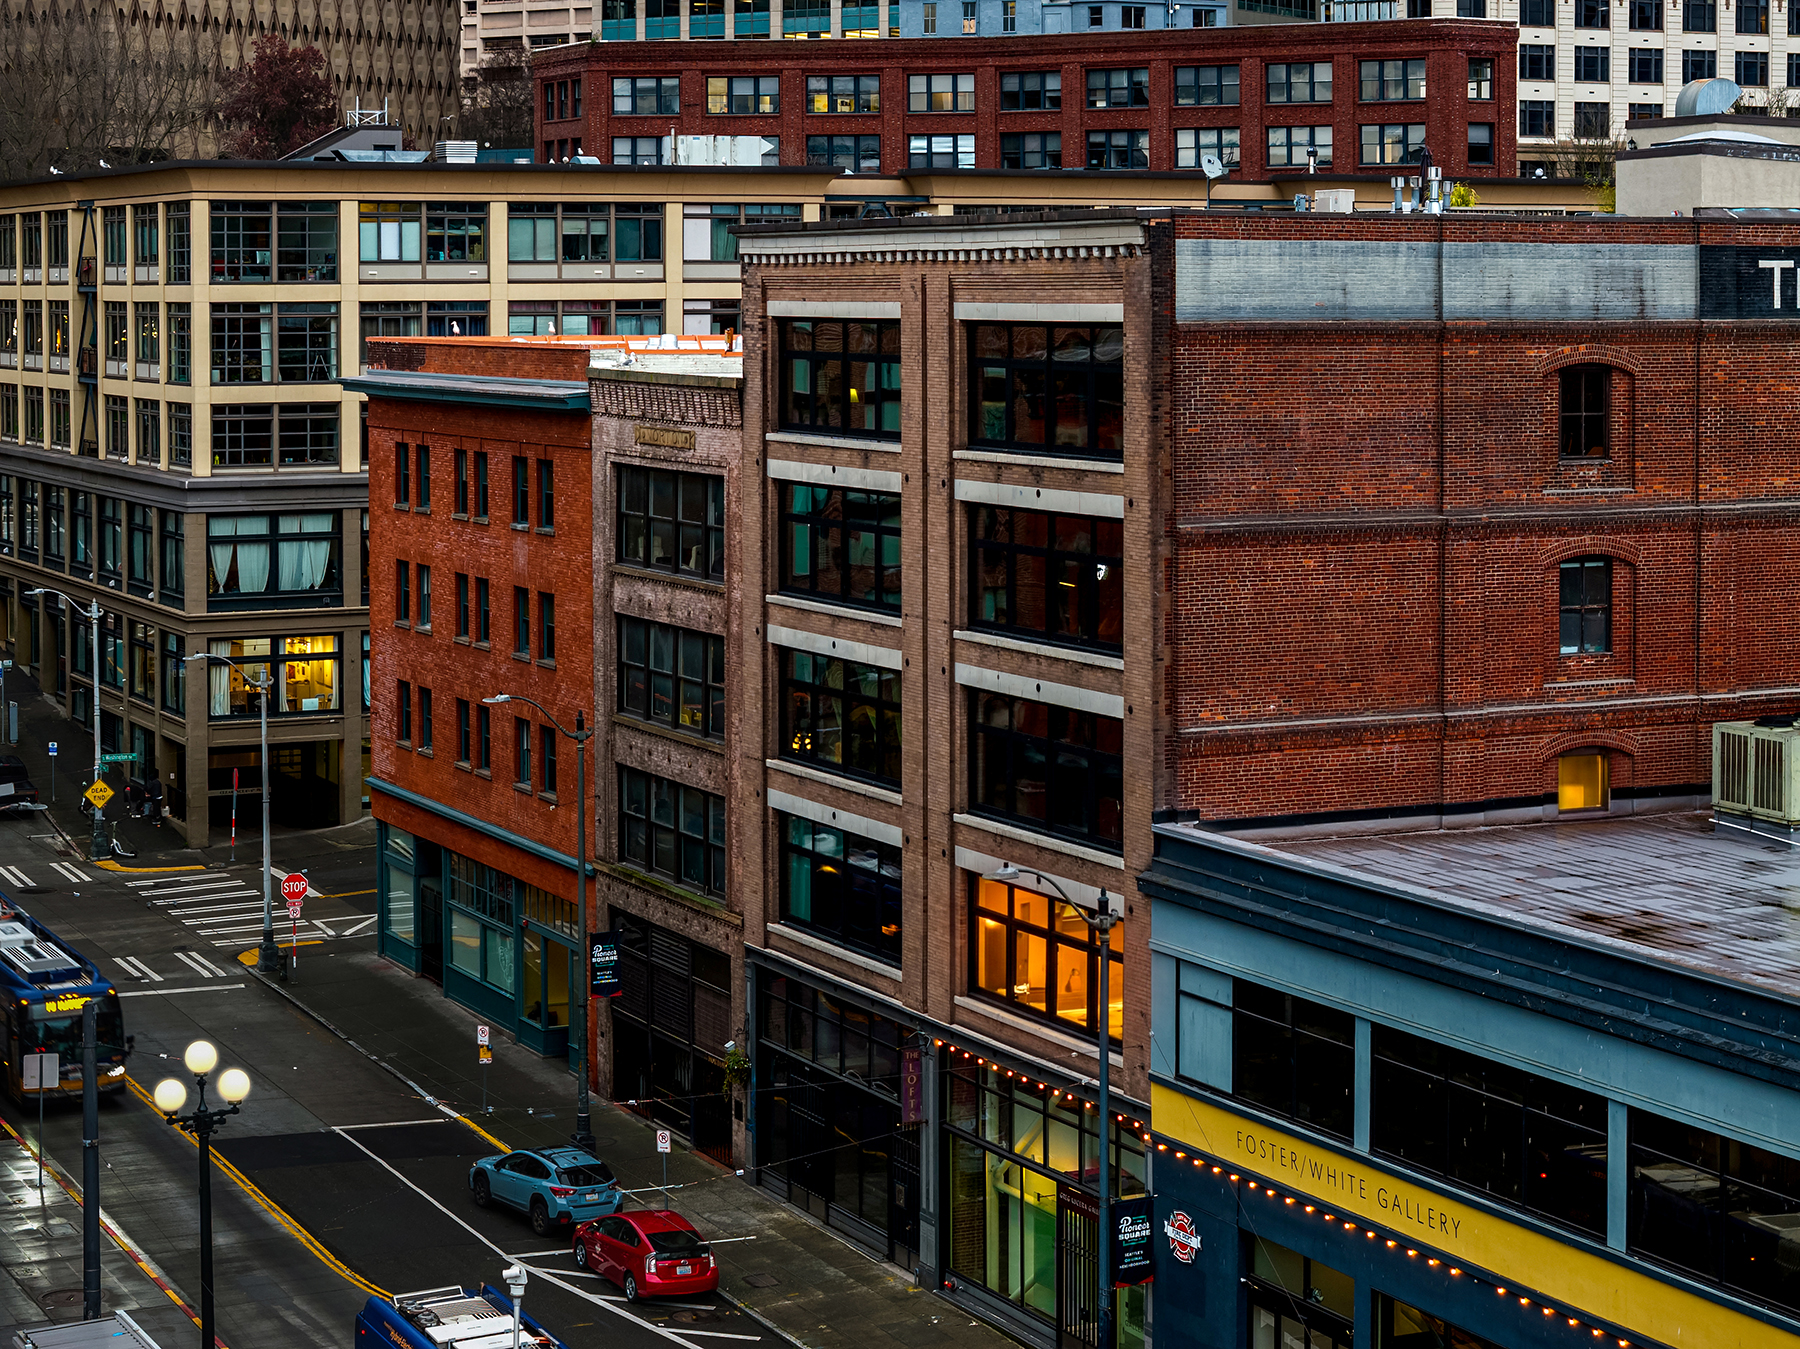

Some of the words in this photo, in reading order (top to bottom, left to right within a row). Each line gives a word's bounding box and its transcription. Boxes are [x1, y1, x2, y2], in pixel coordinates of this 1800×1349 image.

[645, 429, 685, 446] NORTON
[283, 881, 306, 893] STOP
[906, 1051, 919, 1060] THE
[907, 1063, 917, 1121] LOFTS
[1236, 1130, 1367, 1200] FOSTER/WHITE
[1377, 1188, 1461, 1239] GALLERY
[1119, 1216, 1150, 1233] Pioneer
[1119, 1229, 1150, 1240] SQUARE
